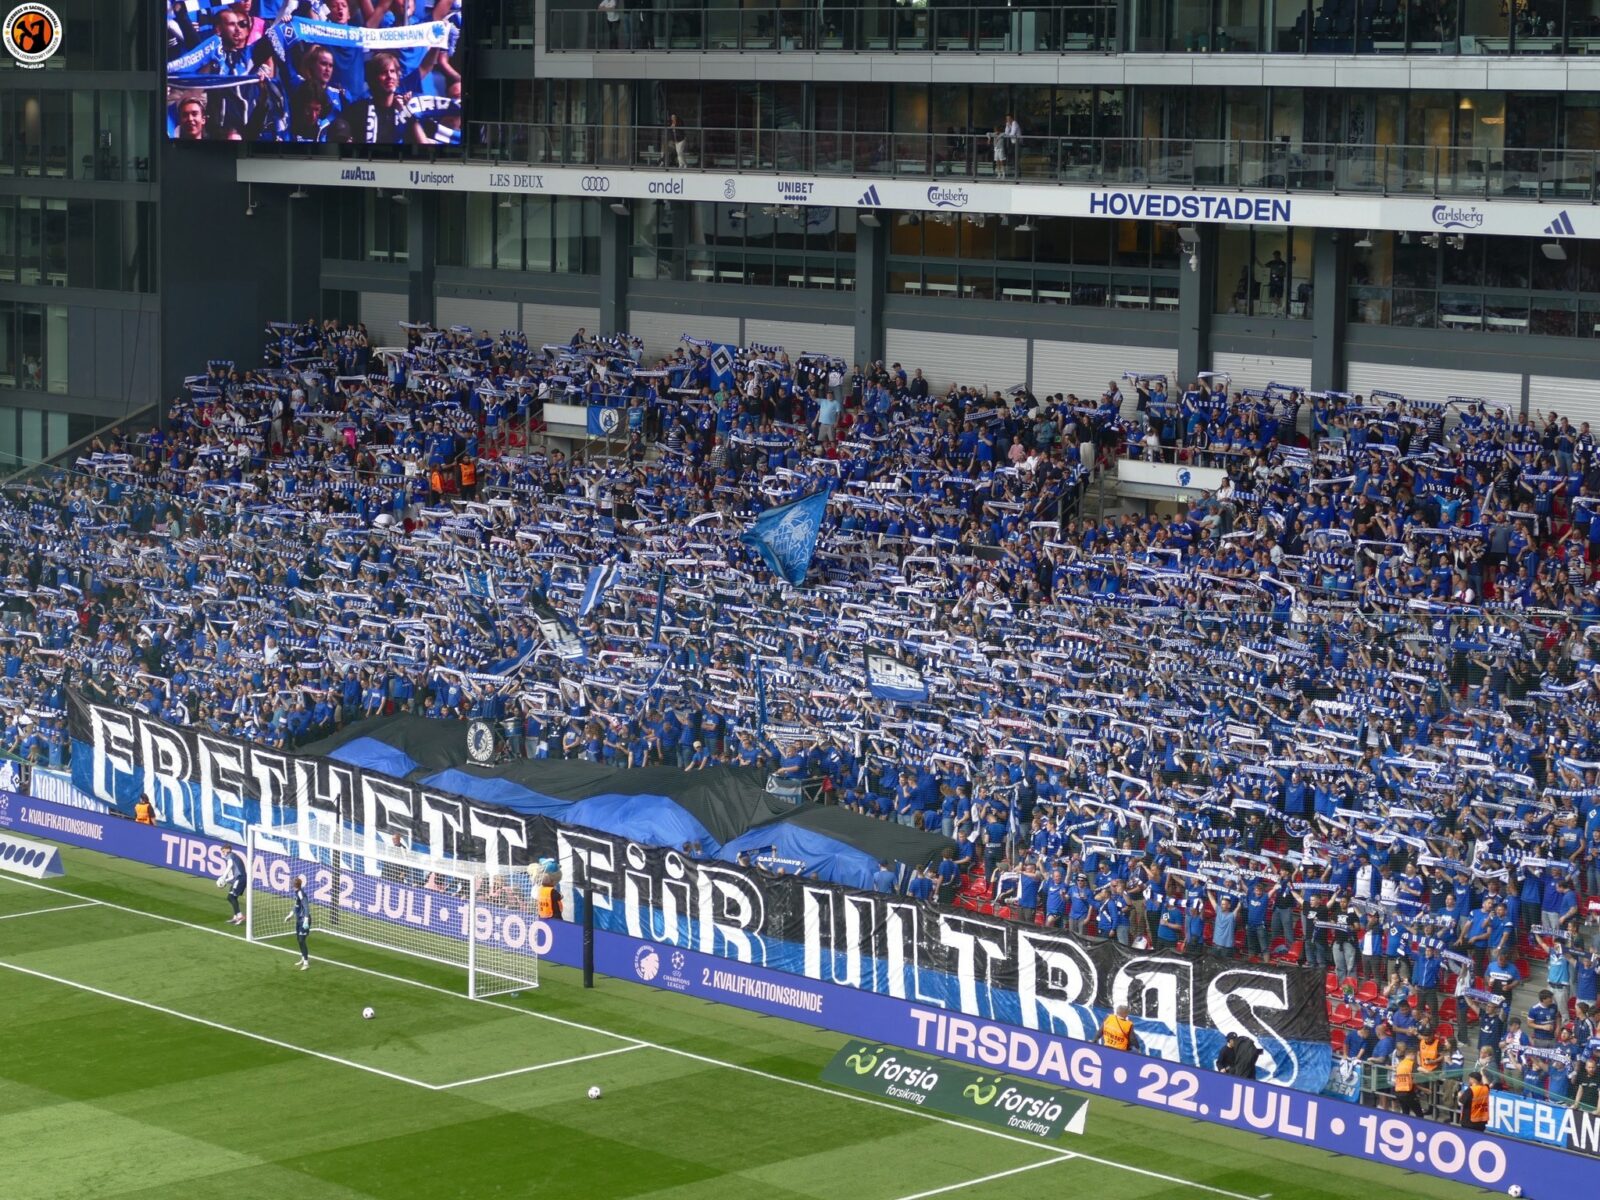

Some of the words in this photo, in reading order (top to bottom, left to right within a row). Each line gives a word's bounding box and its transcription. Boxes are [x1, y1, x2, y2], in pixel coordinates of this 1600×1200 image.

[341, 166, 376, 182] LAVAZZA
[420, 170, 454, 186] unisport
[489, 173, 510, 187] LES
[513, 175, 544, 189] DEUX
[648, 178, 684, 195] andel
[777, 181, 814, 194] UNIBET
[927, 186, 968, 208] Carlsberg
[1090, 192, 1291, 223] HOVEDSTADEN
[1432, 205, 1484, 229] Carlsberg
[89, 703, 528, 886] FREIHEIT
[20, 807, 28, 822] 2.
[29, 808, 104, 841] KVALIFIKATIONSRUNDE
[557, 828, 768, 970] FÜR
[314, 869, 361, 910] 22.
[367, 882, 431, 926] JULI
[457, 902, 554, 956] 19:00
[662, 974, 691, 986] CHAMPIONS
[666, 981, 686, 991] LEAGUE
[702, 967, 712, 987] 2.
[713, 970, 824, 1014] KVALIFIKATIONSRUNDE
[803, 886, 1299, 1090] ULTRAS
[874, 1057, 939, 1091] forsia
[886, 1084, 926, 1105] forsikring
[909, 1008, 1102, 1089] TIRSDAG
[1137, 1063, 1209, 1117] 22.
[1220, 1084, 1319, 1142] JULI
[1359, 1114, 1507, 1184] 19:00
[994, 1087, 1063, 1122] forsia
[1007, 1115, 1051, 1138] forsikring
